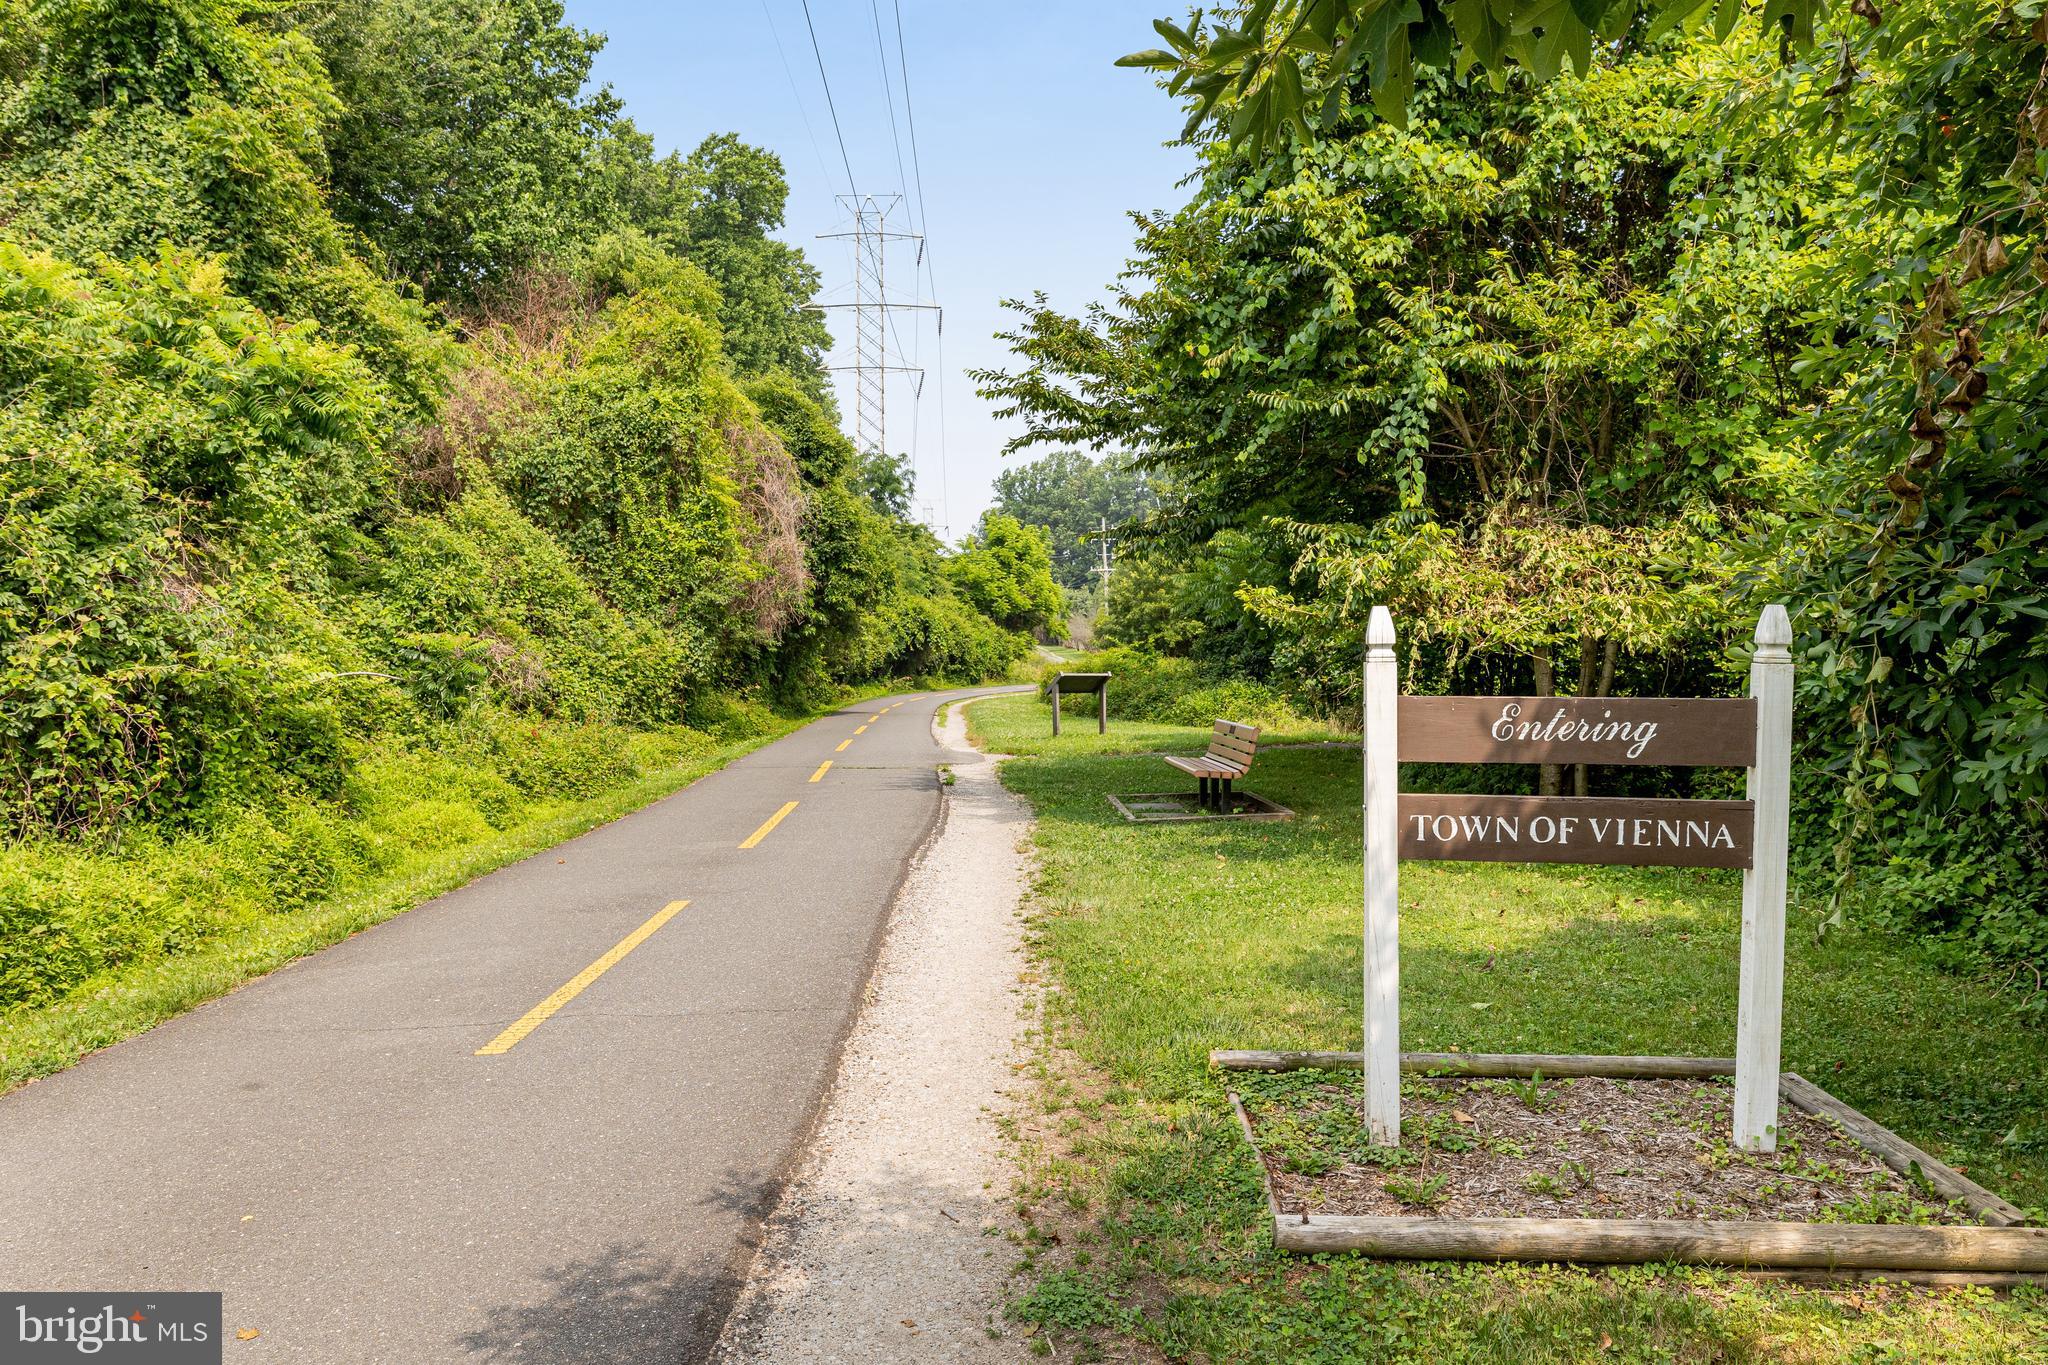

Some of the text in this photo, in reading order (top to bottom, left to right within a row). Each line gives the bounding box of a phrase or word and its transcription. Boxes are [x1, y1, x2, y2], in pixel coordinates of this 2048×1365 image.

[1491, 703, 1659, 759] Entering
[1410, 814, 1736, 849] TOWN OF VIENNA
